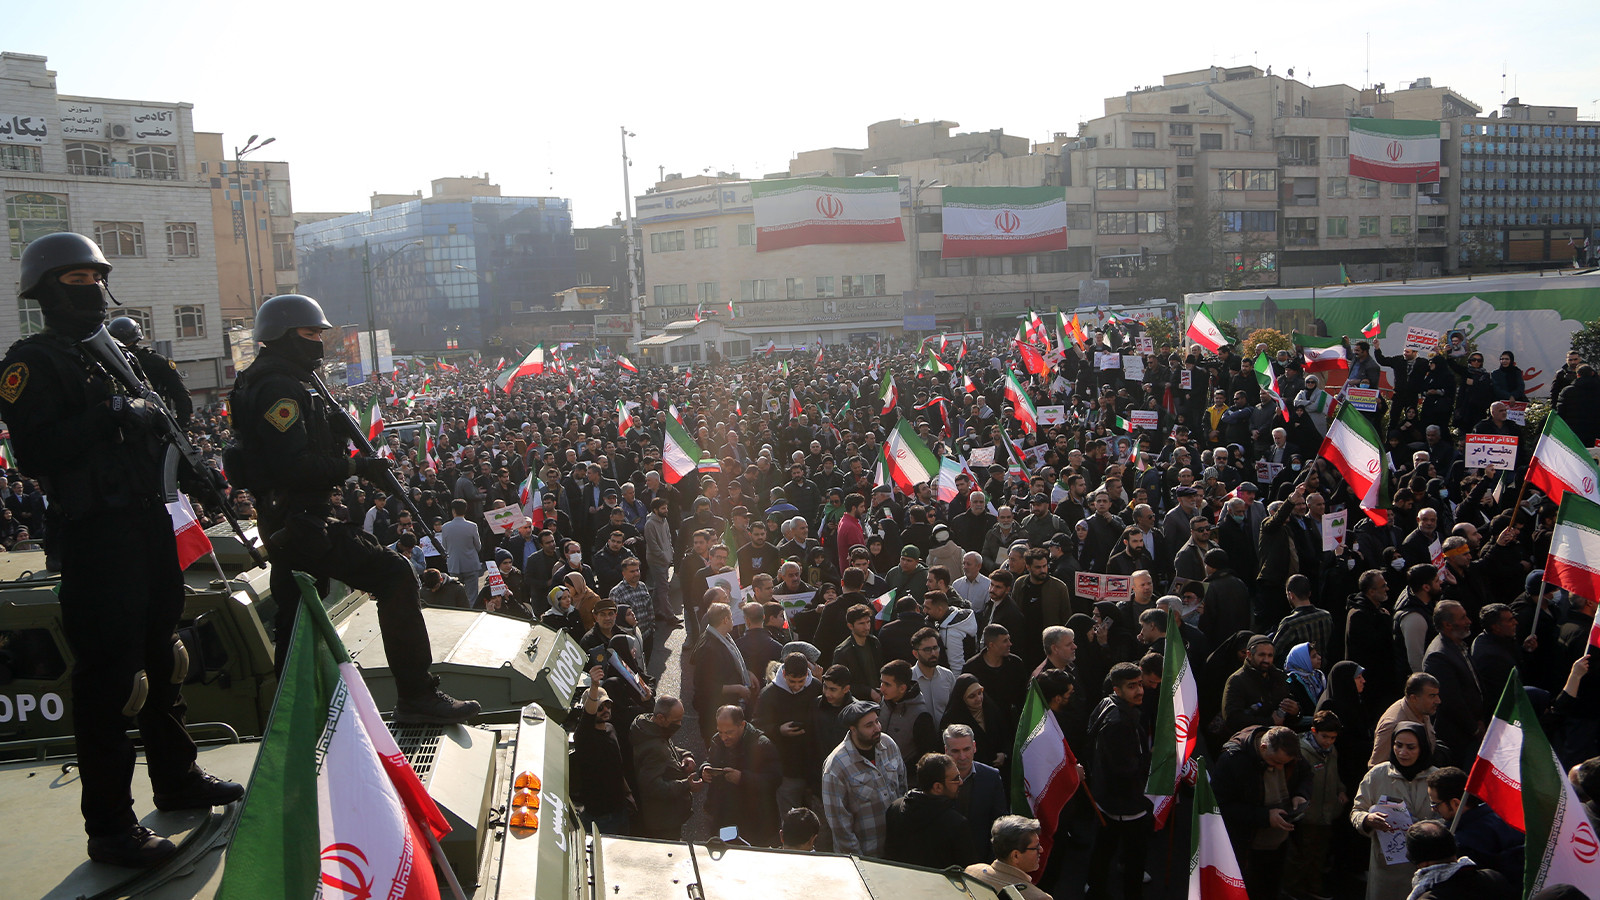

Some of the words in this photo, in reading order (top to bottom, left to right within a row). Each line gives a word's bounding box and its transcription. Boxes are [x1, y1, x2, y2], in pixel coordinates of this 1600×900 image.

[68, 106, 92, 114] آموزش
[134, 110, 174, 123] آکادمی
[0, 116, 47, 142] نیکای
[63, 125, 95, 134] کامپیوتری
[136, 126, 172, 139] حنفی
[1471, 445, 1486, 455] امر
[1487, 446, 1513, 456] مطیع
[1478, 457, 1509, 468] رهبریم
[550, 641, 582, 700] NOPO
[0, 692, 64, 723] OPO
[543, 792, 568, 852] پلیس
